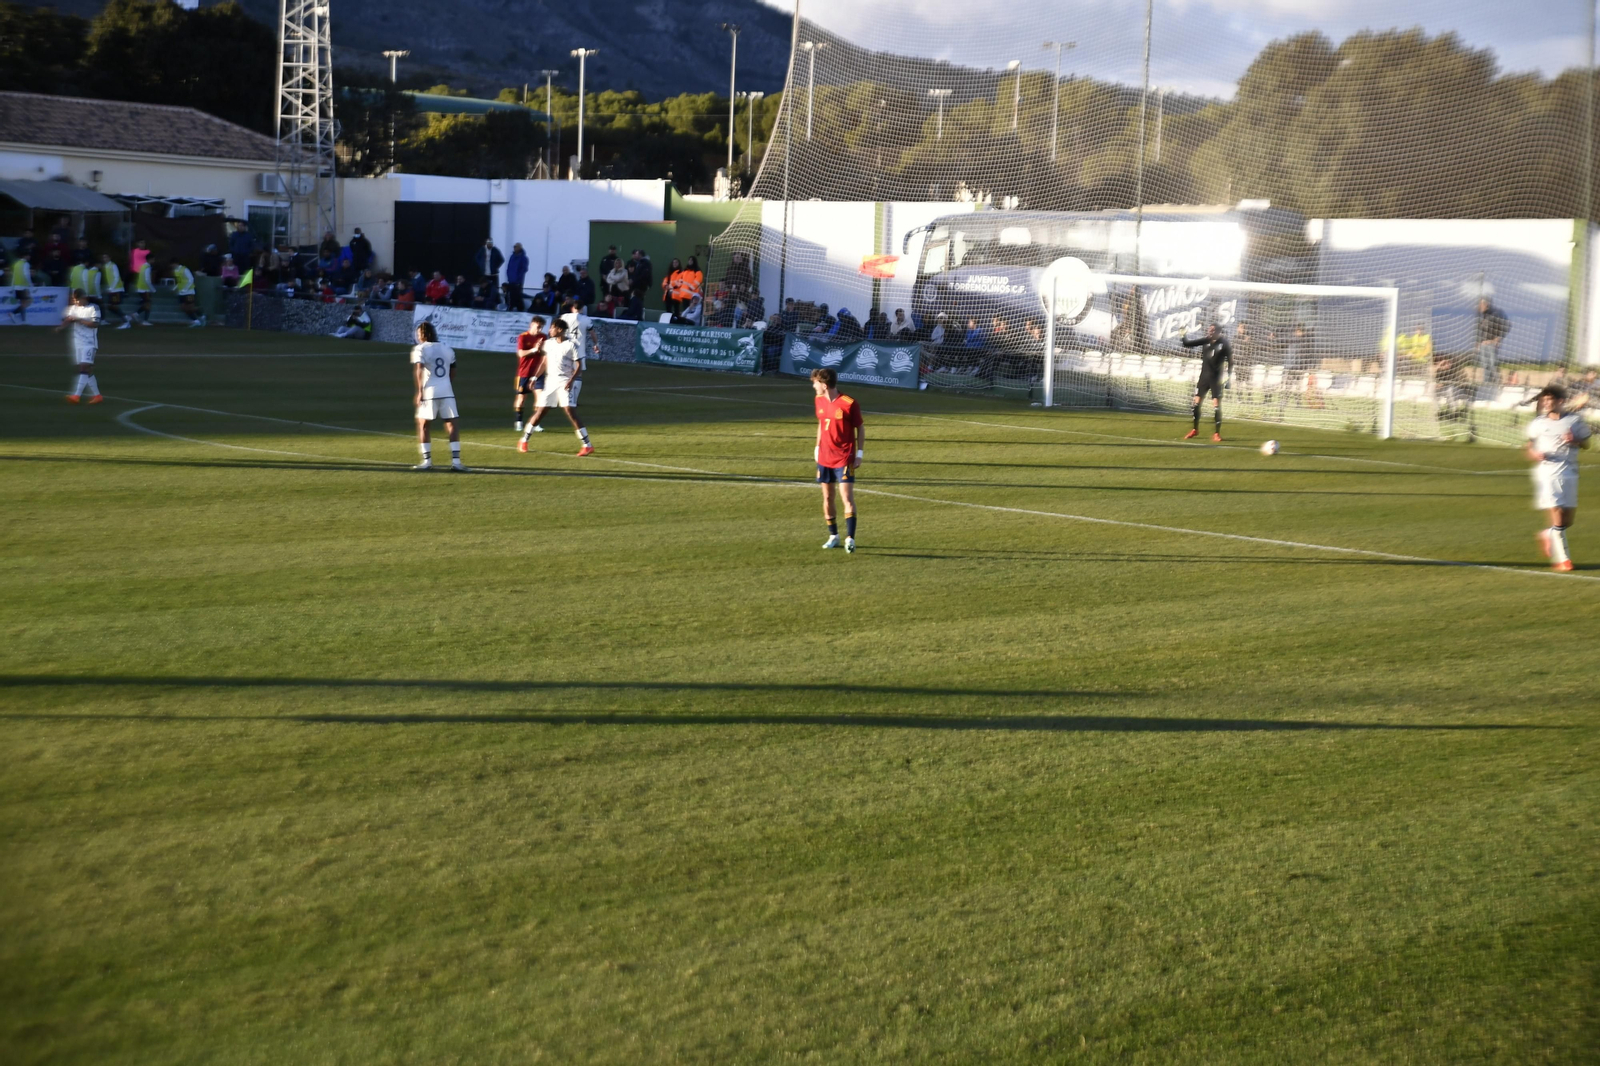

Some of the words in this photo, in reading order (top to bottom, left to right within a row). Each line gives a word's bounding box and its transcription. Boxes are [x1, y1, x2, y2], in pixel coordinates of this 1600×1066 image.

[968, 275, 1009, 285] JUVENTUD
[950, 282, 1010, 294] TORREMOLINOS
[1144, 277, 1210, 314] VAMOS
[665, 327, 695, 337] PESCADOS
[701, 330, 732, 339] MARISCOS
[434, 357, 446, 378] 8
[824, 418, 831, 431] 7
